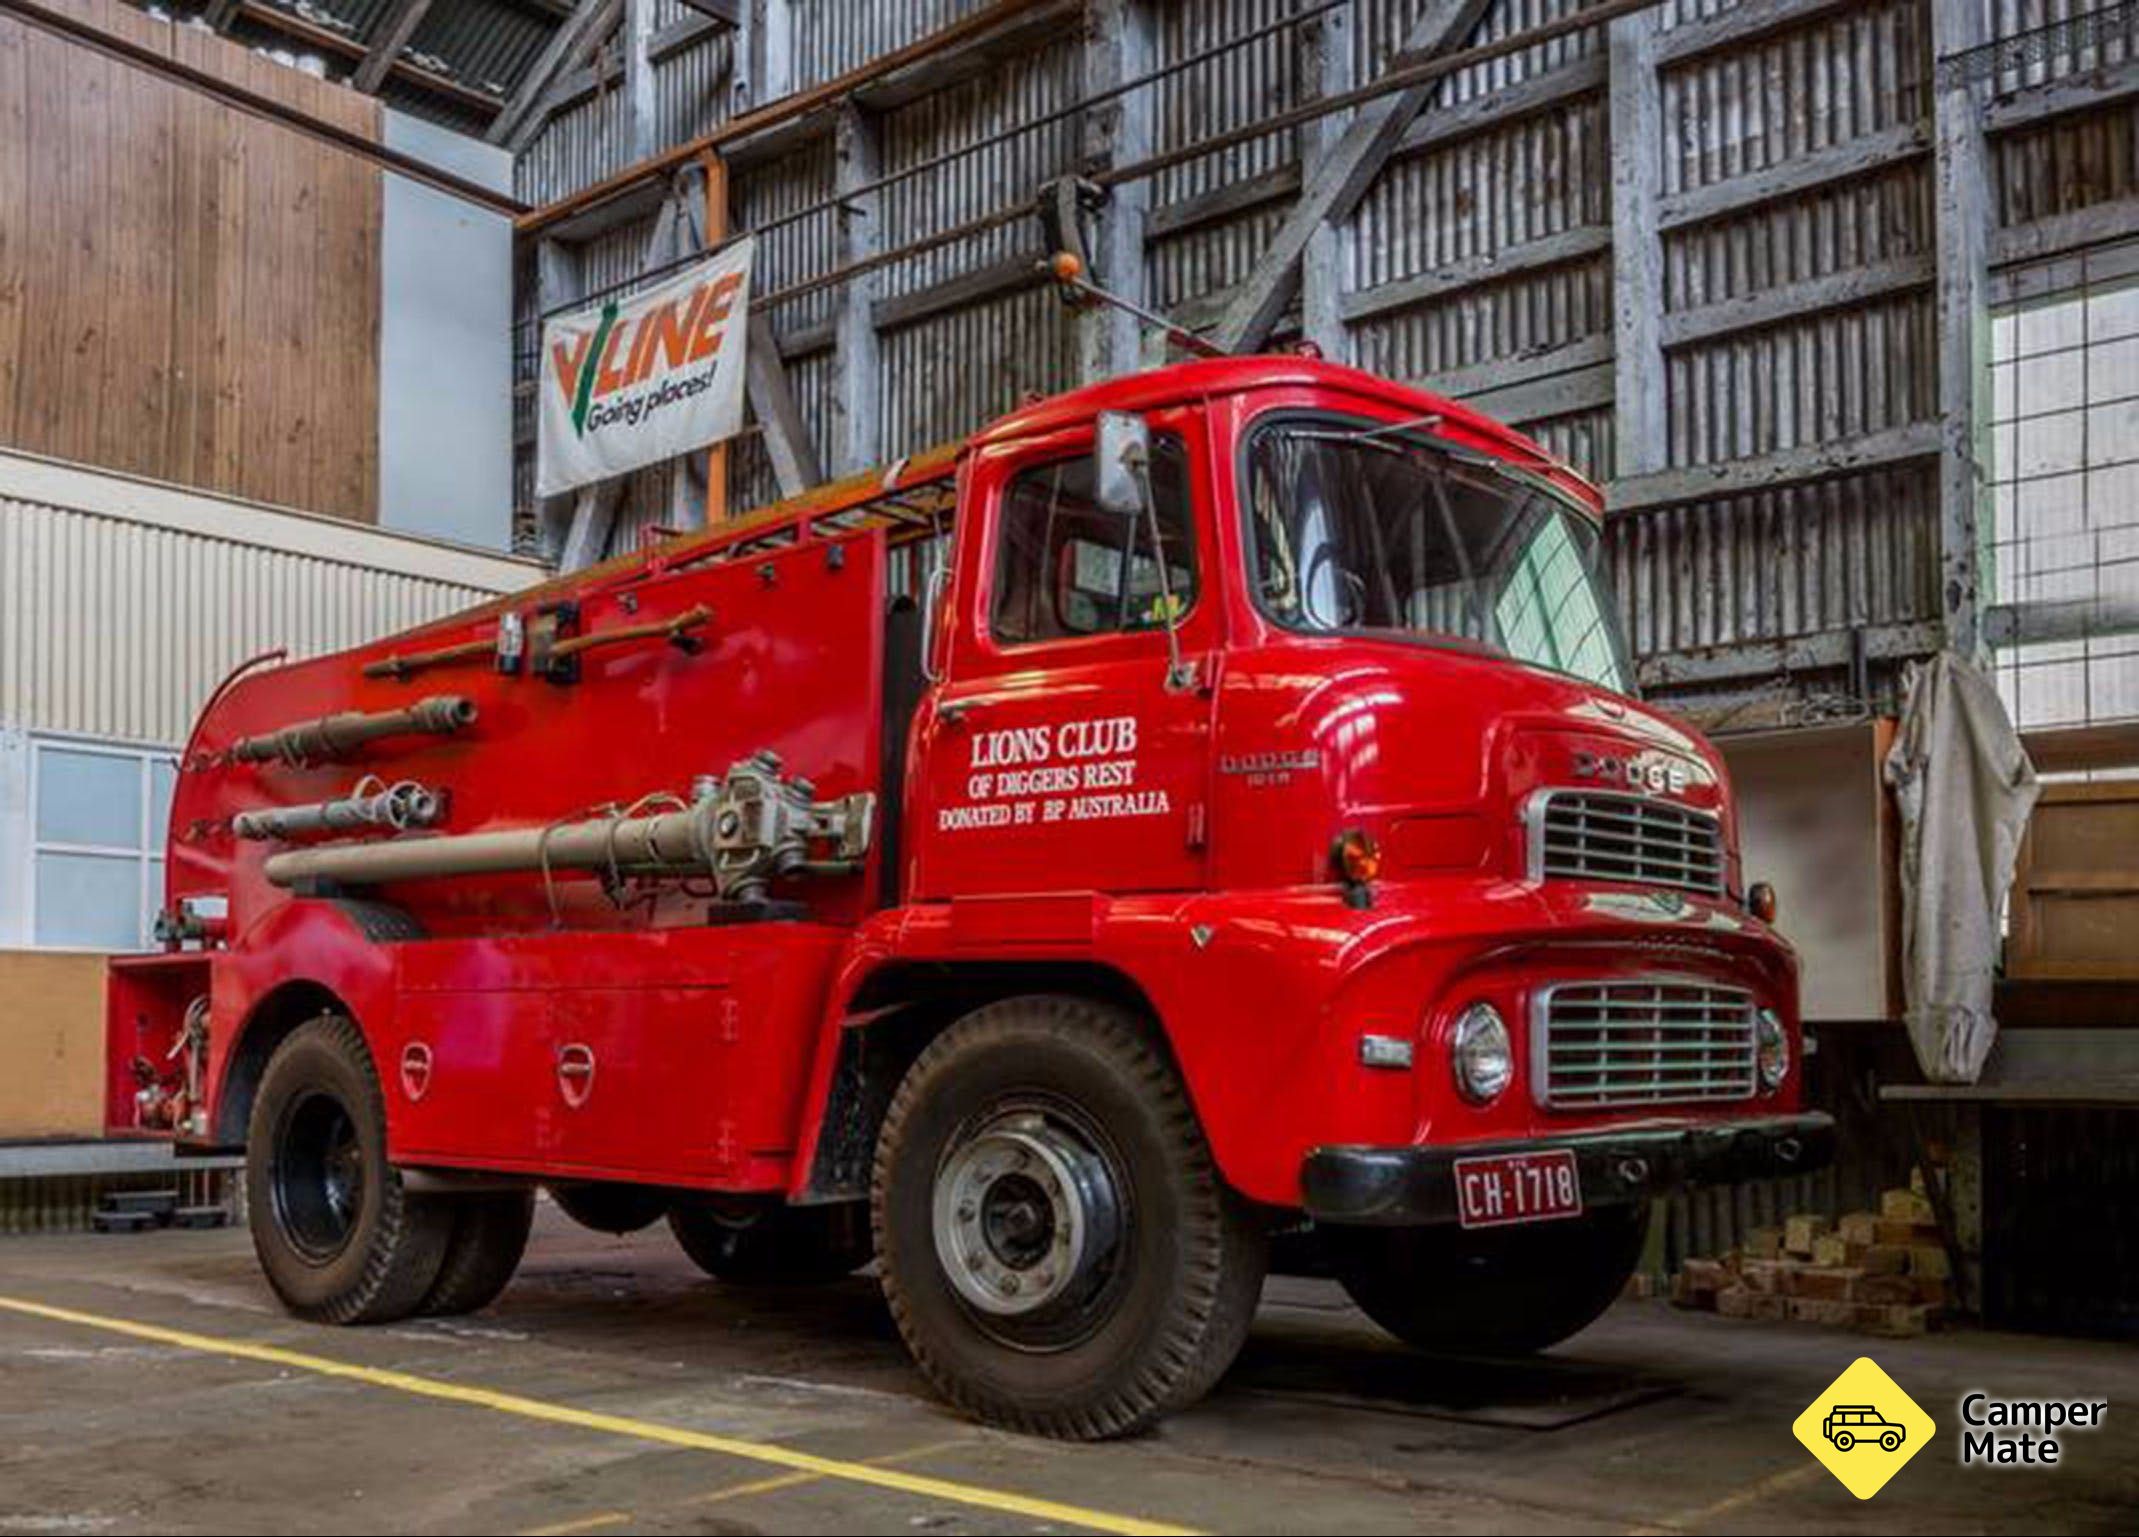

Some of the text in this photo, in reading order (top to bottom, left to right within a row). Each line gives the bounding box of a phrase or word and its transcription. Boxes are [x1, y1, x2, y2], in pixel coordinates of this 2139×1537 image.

[586, 360, 716, 431] Going places!
[970, 716, 1138, 769] LIONS CLUB
[968, 760, 1137, 799] OF DIGGERS REST
[938, 801, 1011, 831] DONATED
[1014, 802, 1035, 824] BY
[1068, 790, 1171, 820] AUSTRALIA
